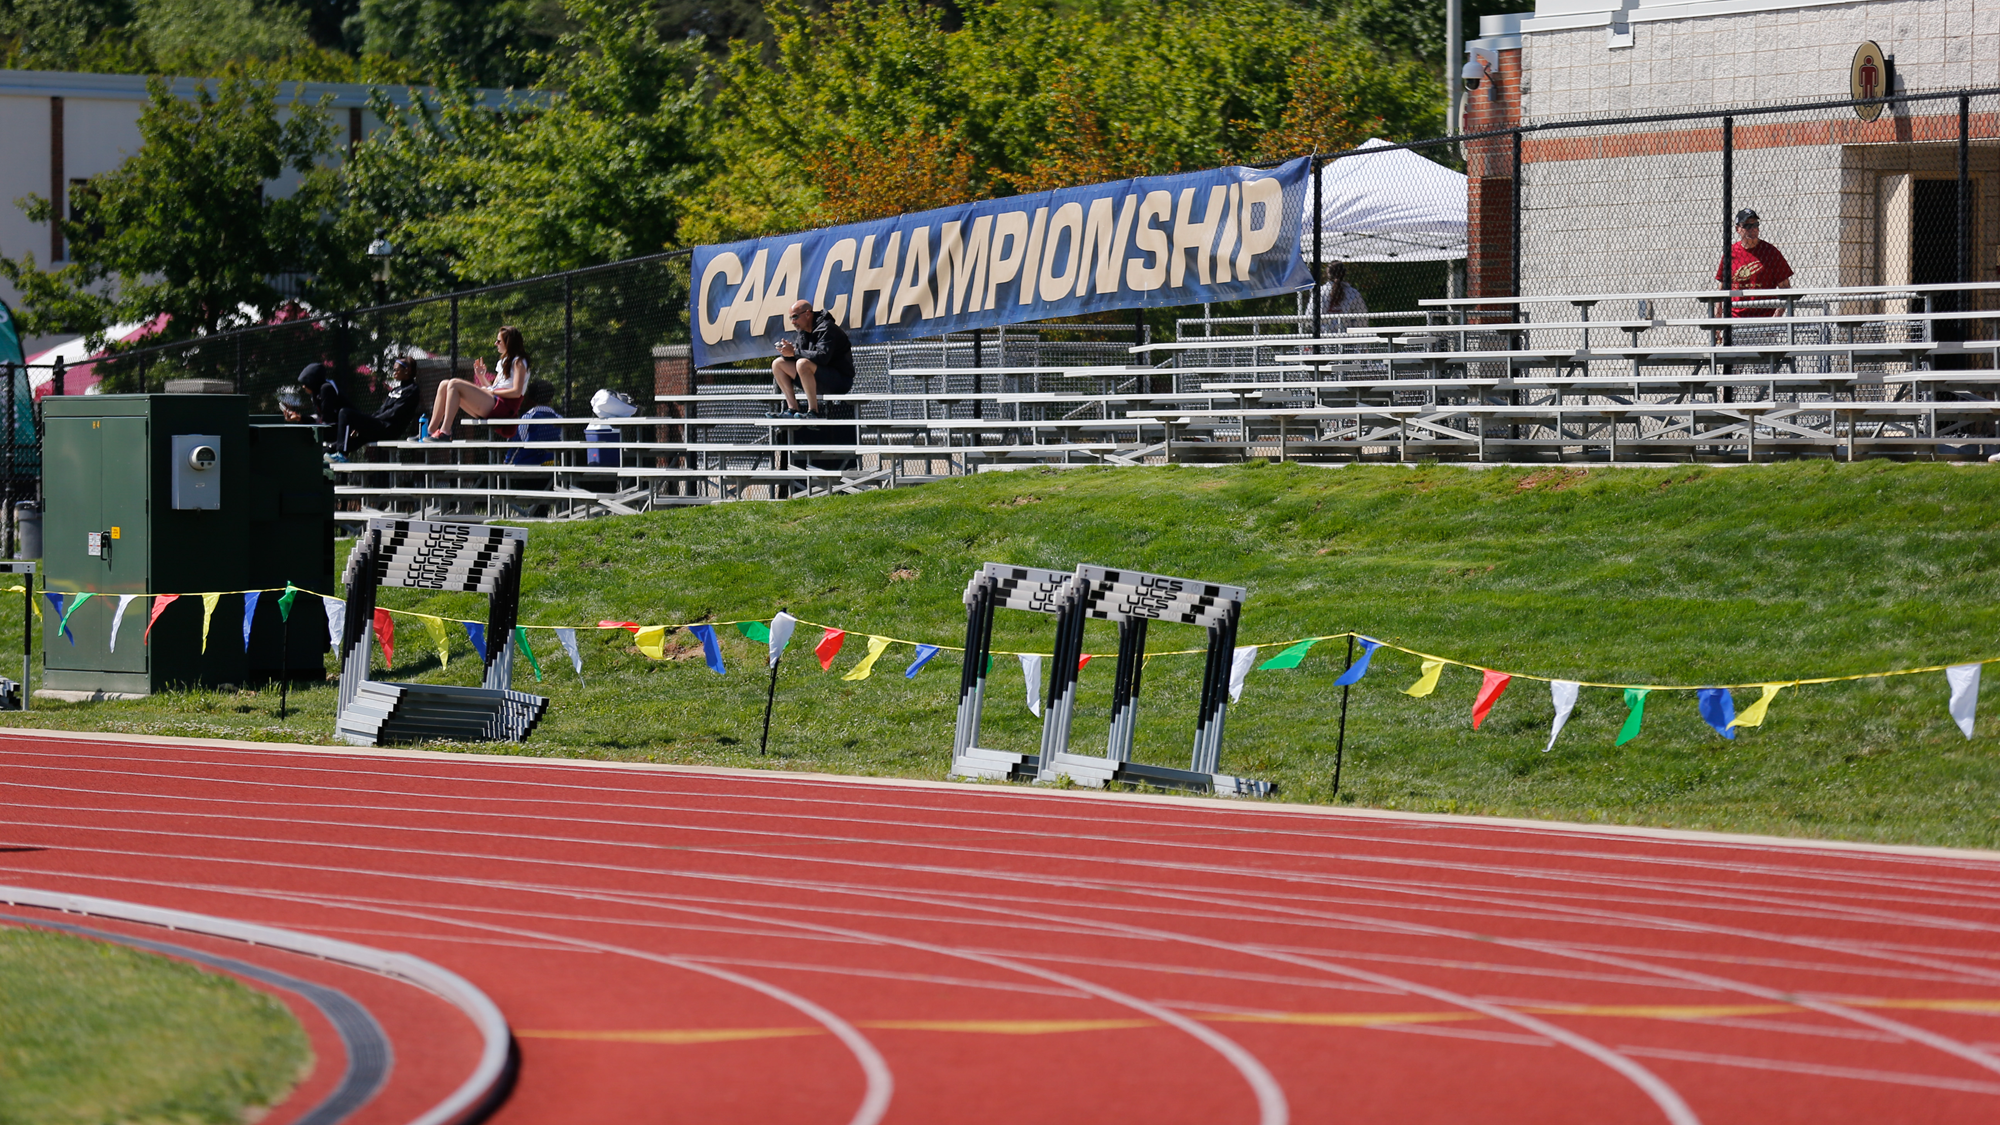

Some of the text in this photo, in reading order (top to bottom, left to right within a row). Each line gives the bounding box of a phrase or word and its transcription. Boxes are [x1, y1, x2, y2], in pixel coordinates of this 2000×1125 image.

[699, 177, 1284, 346] CAA CHAMPIONSHIP
[430, 524, 470, 535] UCS
[425, 540, 463, 550] UCS
[418, 547, 457, 558] UCS
[414, 556, 453, 566] UCS
[409, 564, 448, 573] UCS
[408, 571, 447, 581] UCS
[403, 579, 442, 589] UCS
[1141, 576, 1183, 591] UCS
[1136, 586, 1177, 600] UCS
[1127, 595, 1168, 609] UCS
[1118, 604, 1160, 618] UCS
